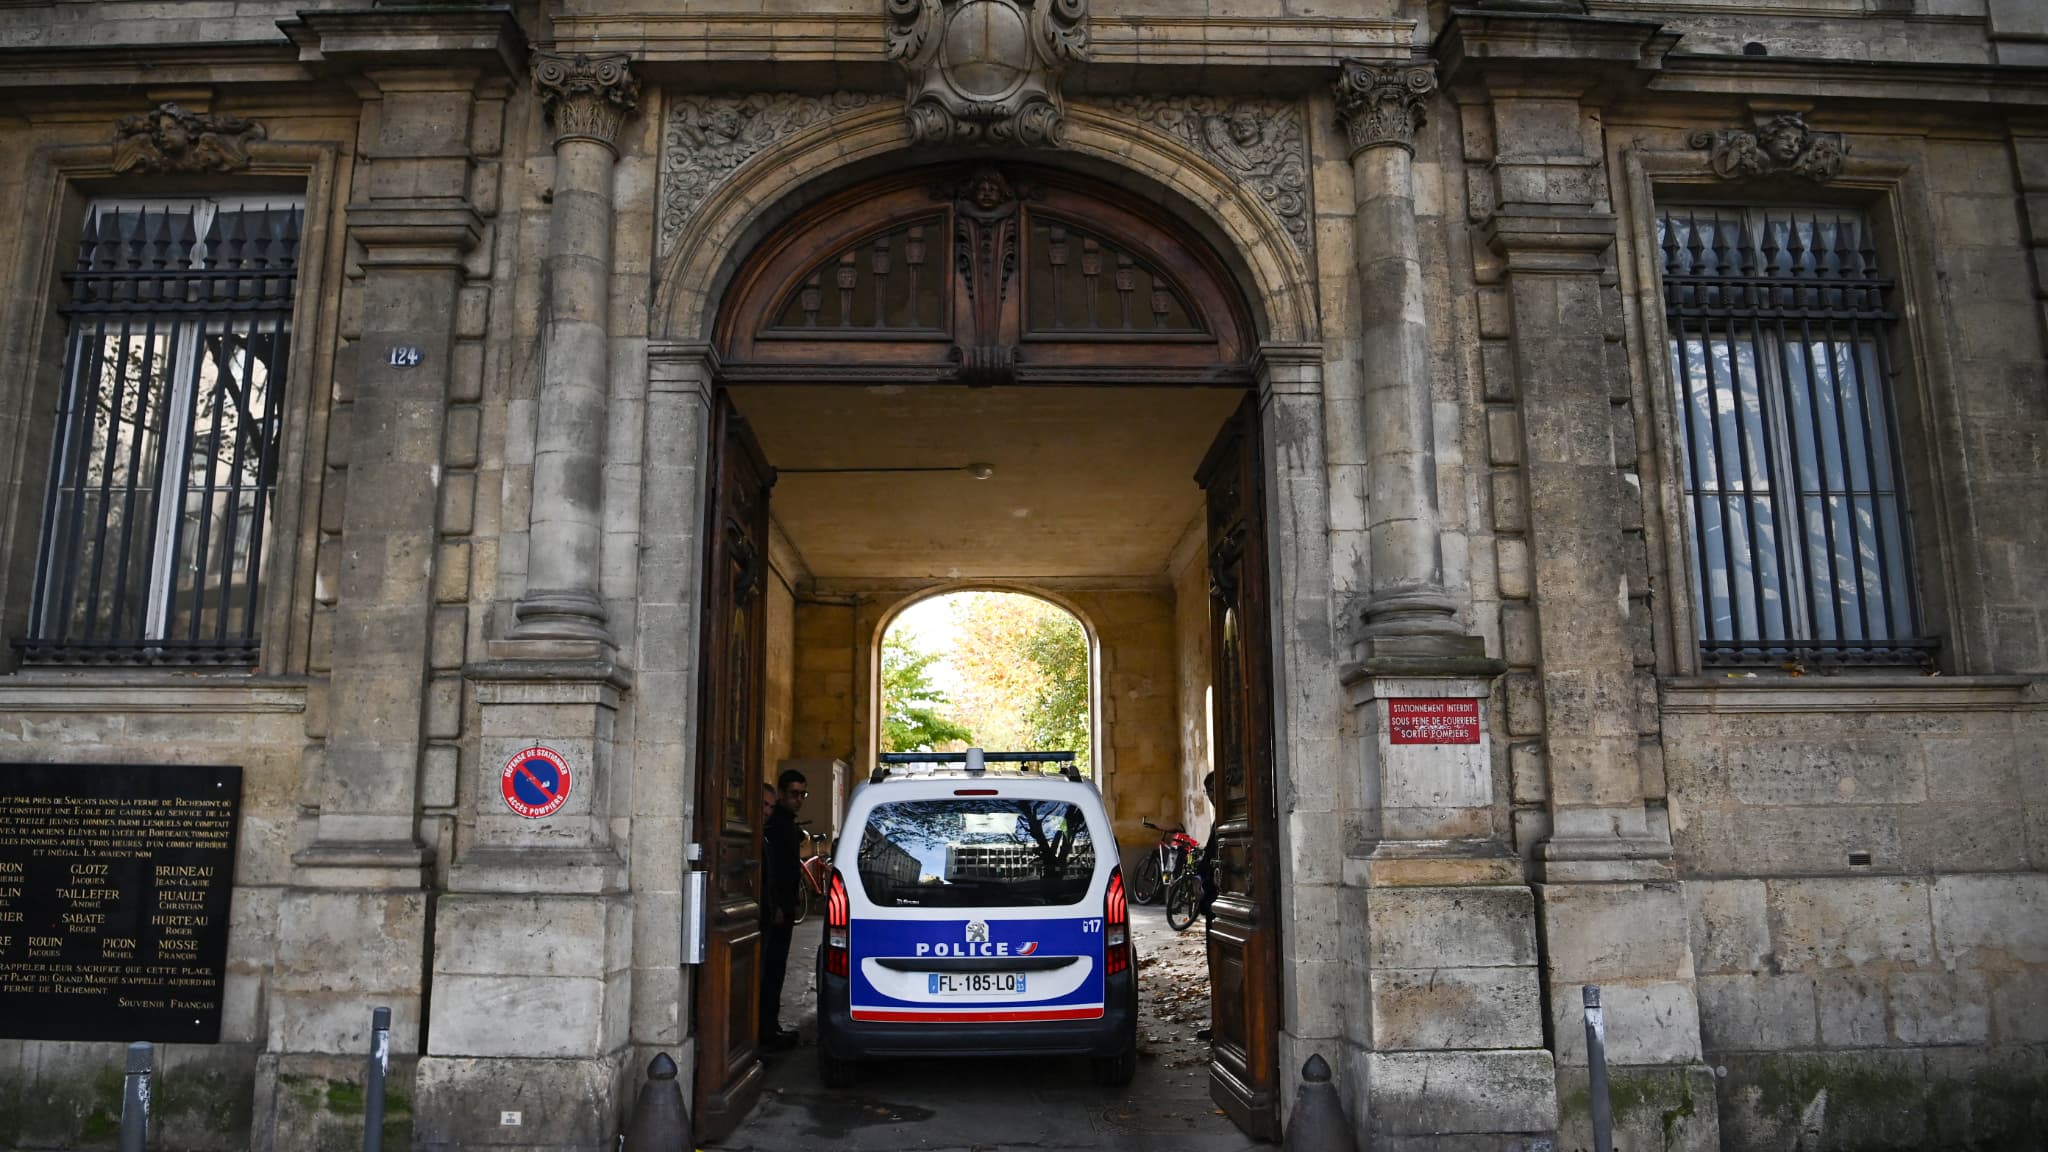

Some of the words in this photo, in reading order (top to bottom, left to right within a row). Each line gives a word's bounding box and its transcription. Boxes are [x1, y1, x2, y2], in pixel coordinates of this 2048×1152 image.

[390, 346, 418, 365] 124
[1394, 704, 1444, 712] STATIONNEMENT
[1447, 704, 1473, 712] INTERDIT
[1392, 716, 1410, 726] SOUS
[1412, 716, 1430, 726] PEINE
[1432, 716, 1441, 725] DE
[1401, 730, 1428, 738] SORTIE
[1432, 730, 1470, 738] POMPIERS
[504, 752, 527, 778] DÉFENSE
[536, 749, 568, 776] STATIONNER
[508, 796, 528, 814] ACCÈS
[529, 794, 564, 816] POMPIERS
[118, 819, 140, 827] PARMI
[143, 820, 181, 828] LESQUELS
[195, 820, 230, 828] COMPTAIT
[88, 839, 110, 847] TROIS
[70, 864, 109, 874] GLOTZ
[155, 866, 214, 877] BRUNEAU
[72, 876, 105, 885] JACQUES
[56, 888, 120, 900] TAILLEFER
[159, 890, 206, 902] HUAULT
[159, 902, 204, 910] CHRISTIAN
[62, 913, 105, 924] SABATE
[152, 915, 208, 926] HURTEAU
[70, 925, 97, 934] ROGER
[166, 926, 193, 935] ROGER
[1088, 920, 1101, 932] 17
[28, 936, 64, 947] ROUIN
[103, 938, 136, 949] PICON
[158, 940, 199, 950] MOSSE
[102, 950, 134, 959] MICHEL
[916, 942, 1008, 956] POLICE
[50, 964, 73, 972] LEUR
[76, 965, 121, 974] SACRIFICE
[146, 966, 178, 974] CETTE
[11, 972, 36, 982] PLACE
[52, 973, 83, 984] GRAND
[940, 974, 1014, 991] FL-185-LQ
[55, 984, 108, 995] RICHEMONT
[118, 996, 165, 1008] SOUVENIR
